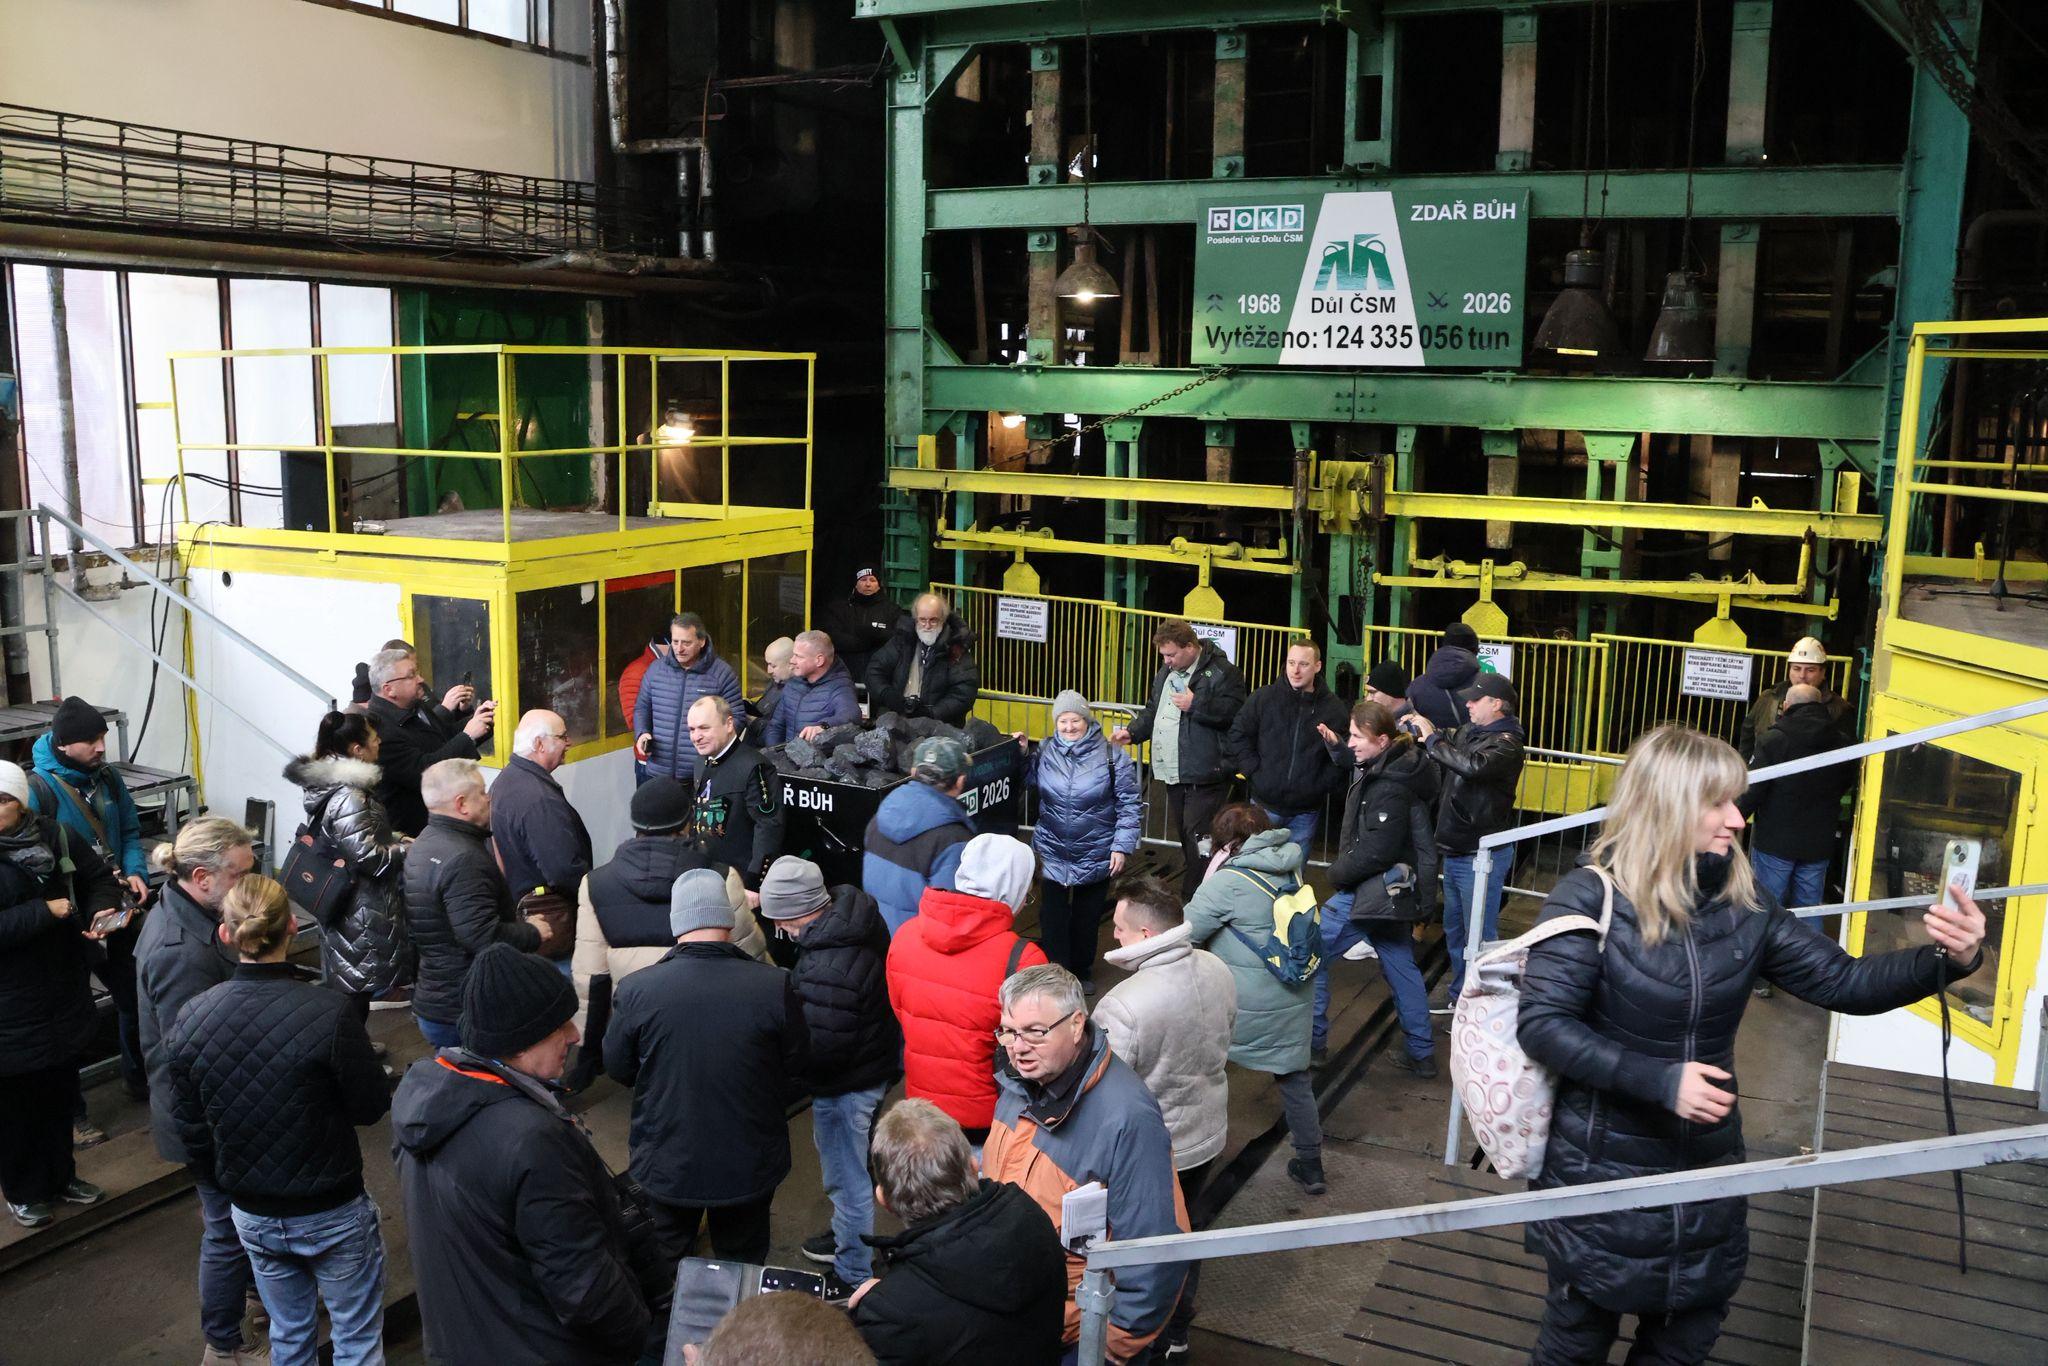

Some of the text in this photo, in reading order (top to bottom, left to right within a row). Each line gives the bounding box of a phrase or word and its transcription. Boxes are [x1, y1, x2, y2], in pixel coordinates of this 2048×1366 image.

[1411, 199, 1516, 222] ZDAŘ BŮH
[1207, 233, 1303, 244] Poslední vůz Dolu ČSM
[1237, 293, 1281, 314] 1968
[1311, 293, 1396, 314] Důl ČSM
[1463, 292, 1511, 314] 2026
[1205, 324, 1510, 354] Vytěženo: 124 335 056 tun
[799, 787, 833, 812] BŮH
[982, 777, 1010, 809] 2026
